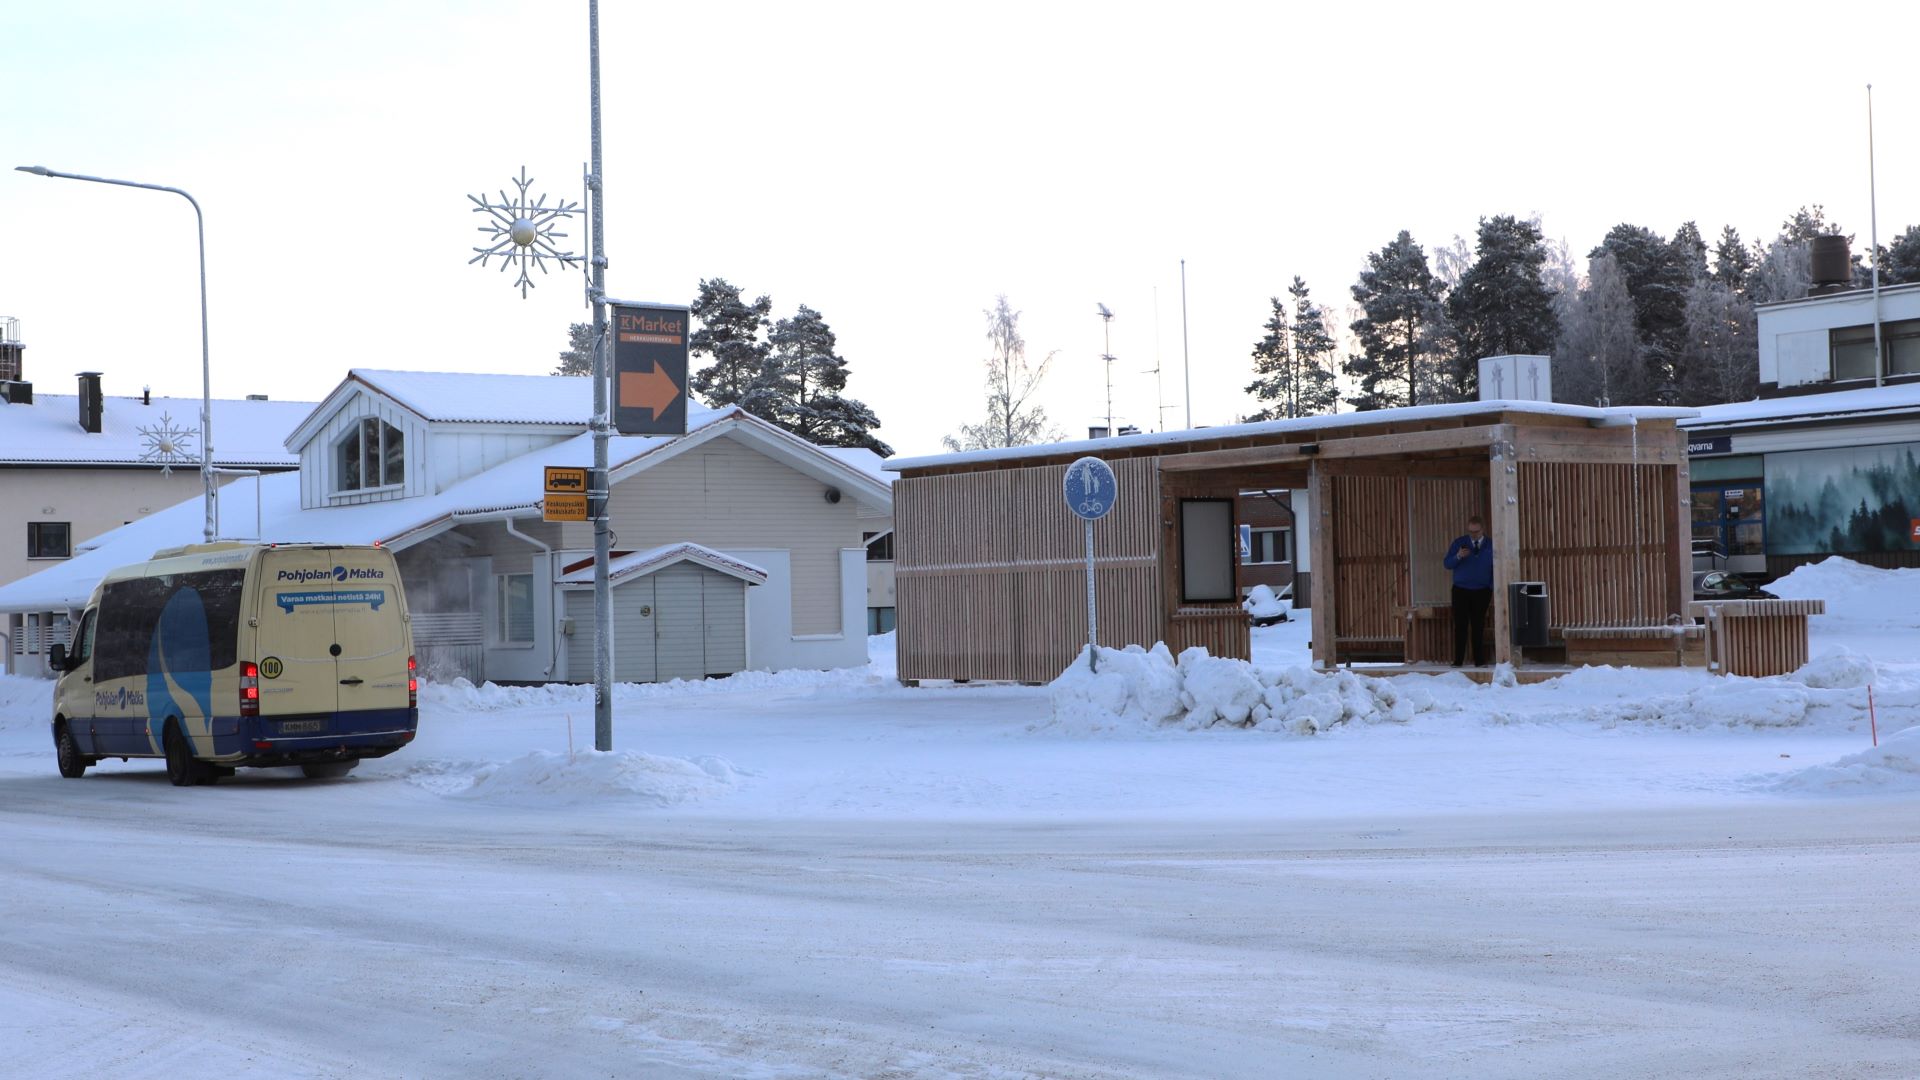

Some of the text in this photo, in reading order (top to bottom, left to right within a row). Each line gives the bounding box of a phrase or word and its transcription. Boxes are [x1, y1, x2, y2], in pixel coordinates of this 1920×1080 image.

[632, 315, 682, 333] Market
[1688, 442, 1713, 453] qvarna
[277, 568, 384, 583] Pohjolan Matka
[305, 594, 336, 602] matkasi
[337, 593, 364, 601] netistä
[365, 592, 382, 600] 24h!
[264, 661, 279, 674] 100
[95, 690, 144, 711] Pohjolan Matka
